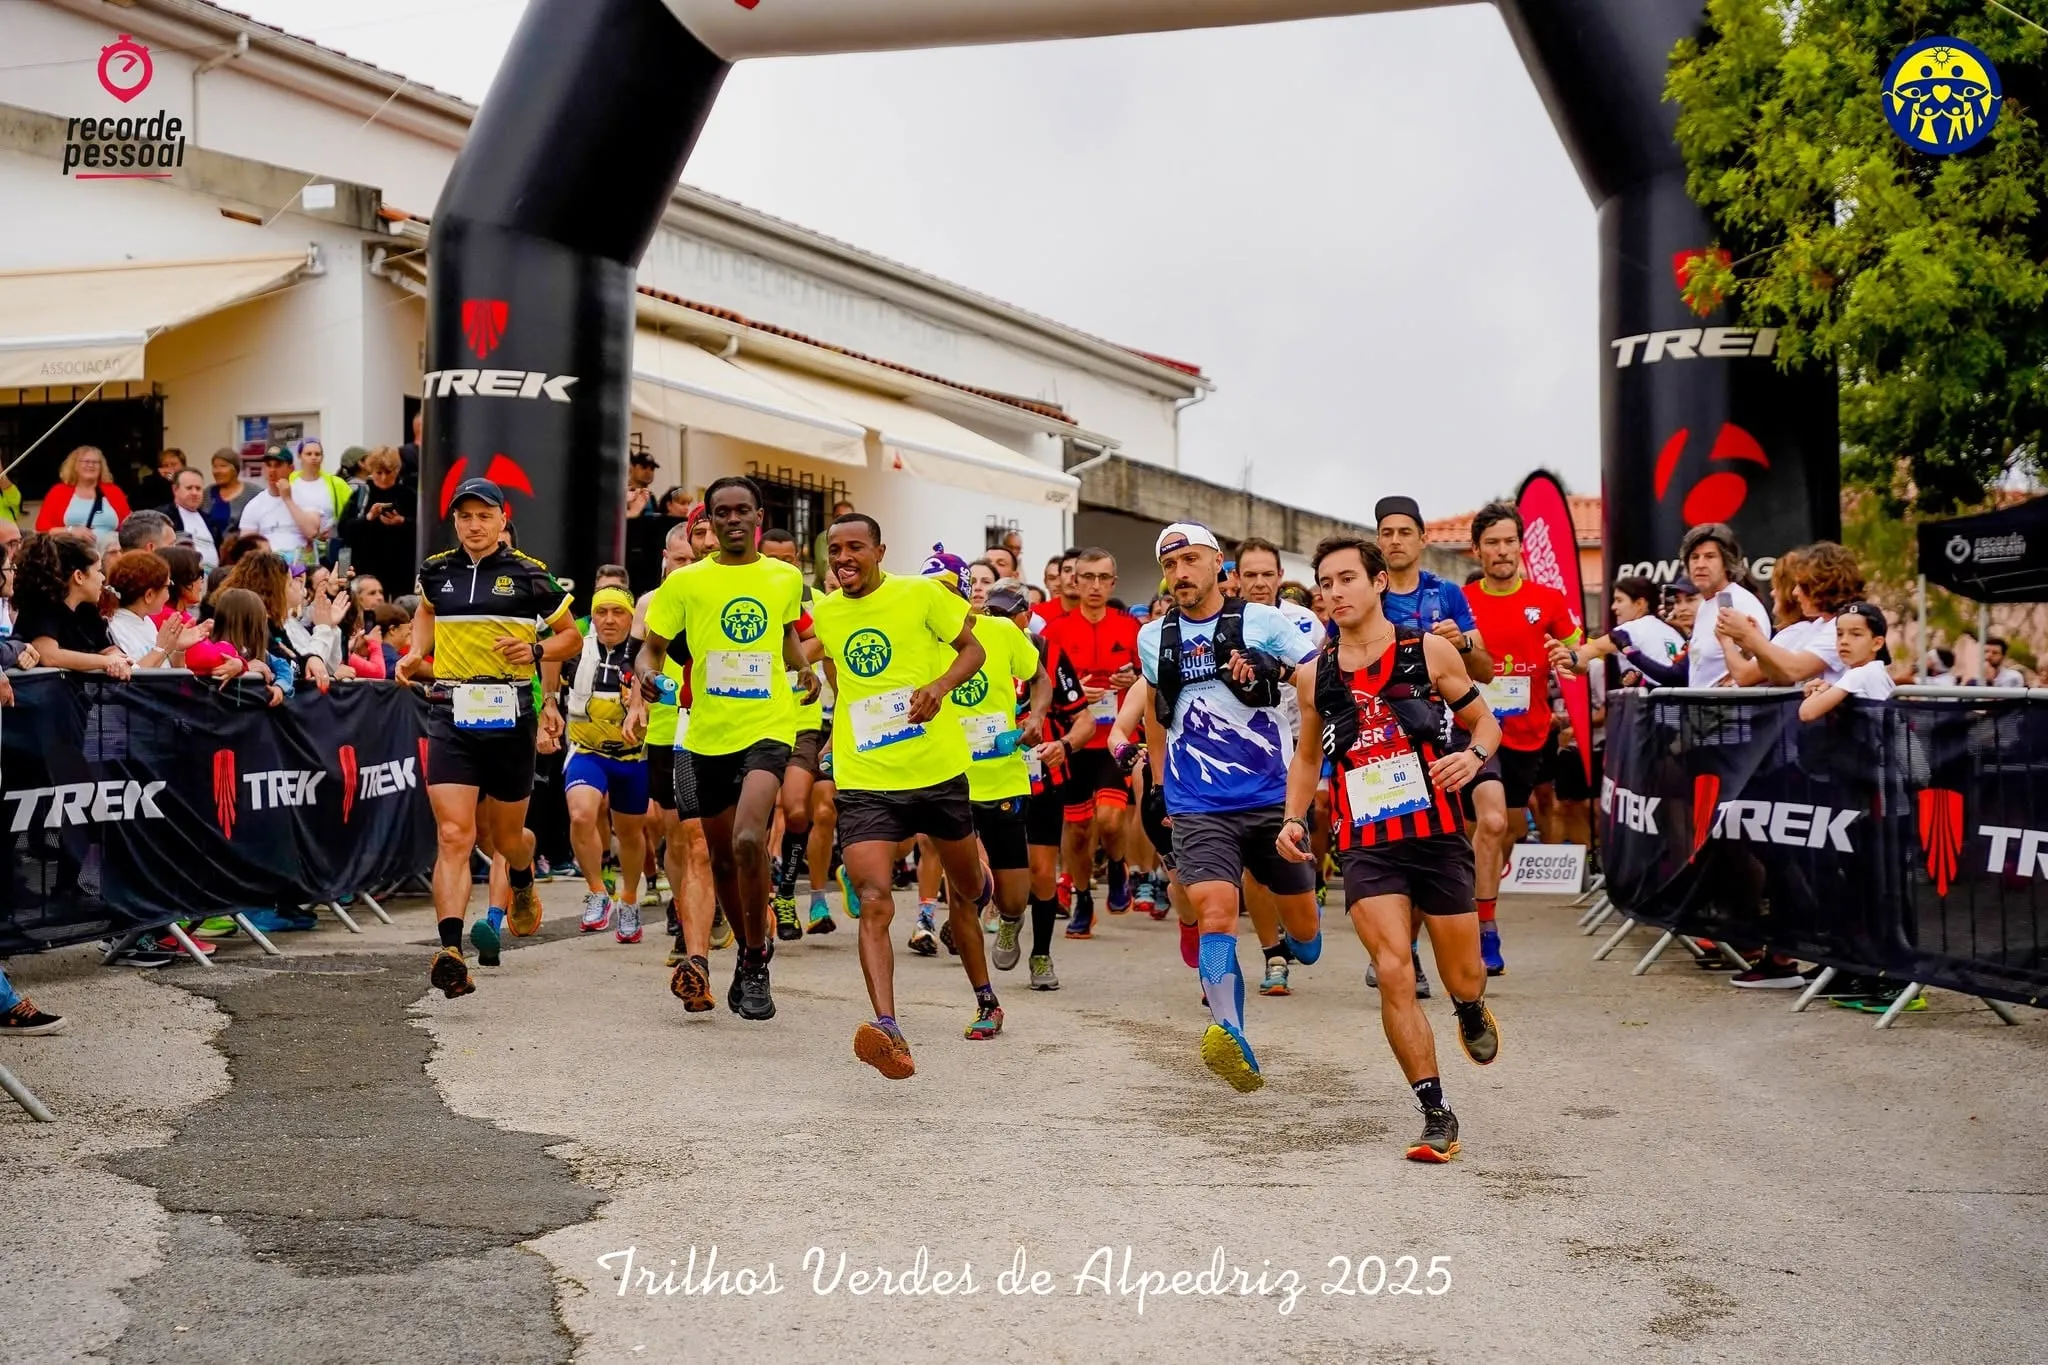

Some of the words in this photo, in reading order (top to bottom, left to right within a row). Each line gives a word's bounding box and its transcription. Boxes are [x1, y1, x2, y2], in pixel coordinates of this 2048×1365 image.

[424, 369, 580, 403] TREK
[749, 664, 758, 673] 91
[493, 696, 503, 704] 40
[893, 702, 905, 713] 93
[986, 725, 997, 733] 92
[360, 756, 416, 799] TREK
[1393, 771, 1407, 783] 60
[243, 770, 327, 810] TREK
[3, 780, 167, 832] TREK
[1712, 799, 1861, 853] TREK
[1519, 853, 1577, 868] recorde
[1515, 866, 1577, 883] pessoal
